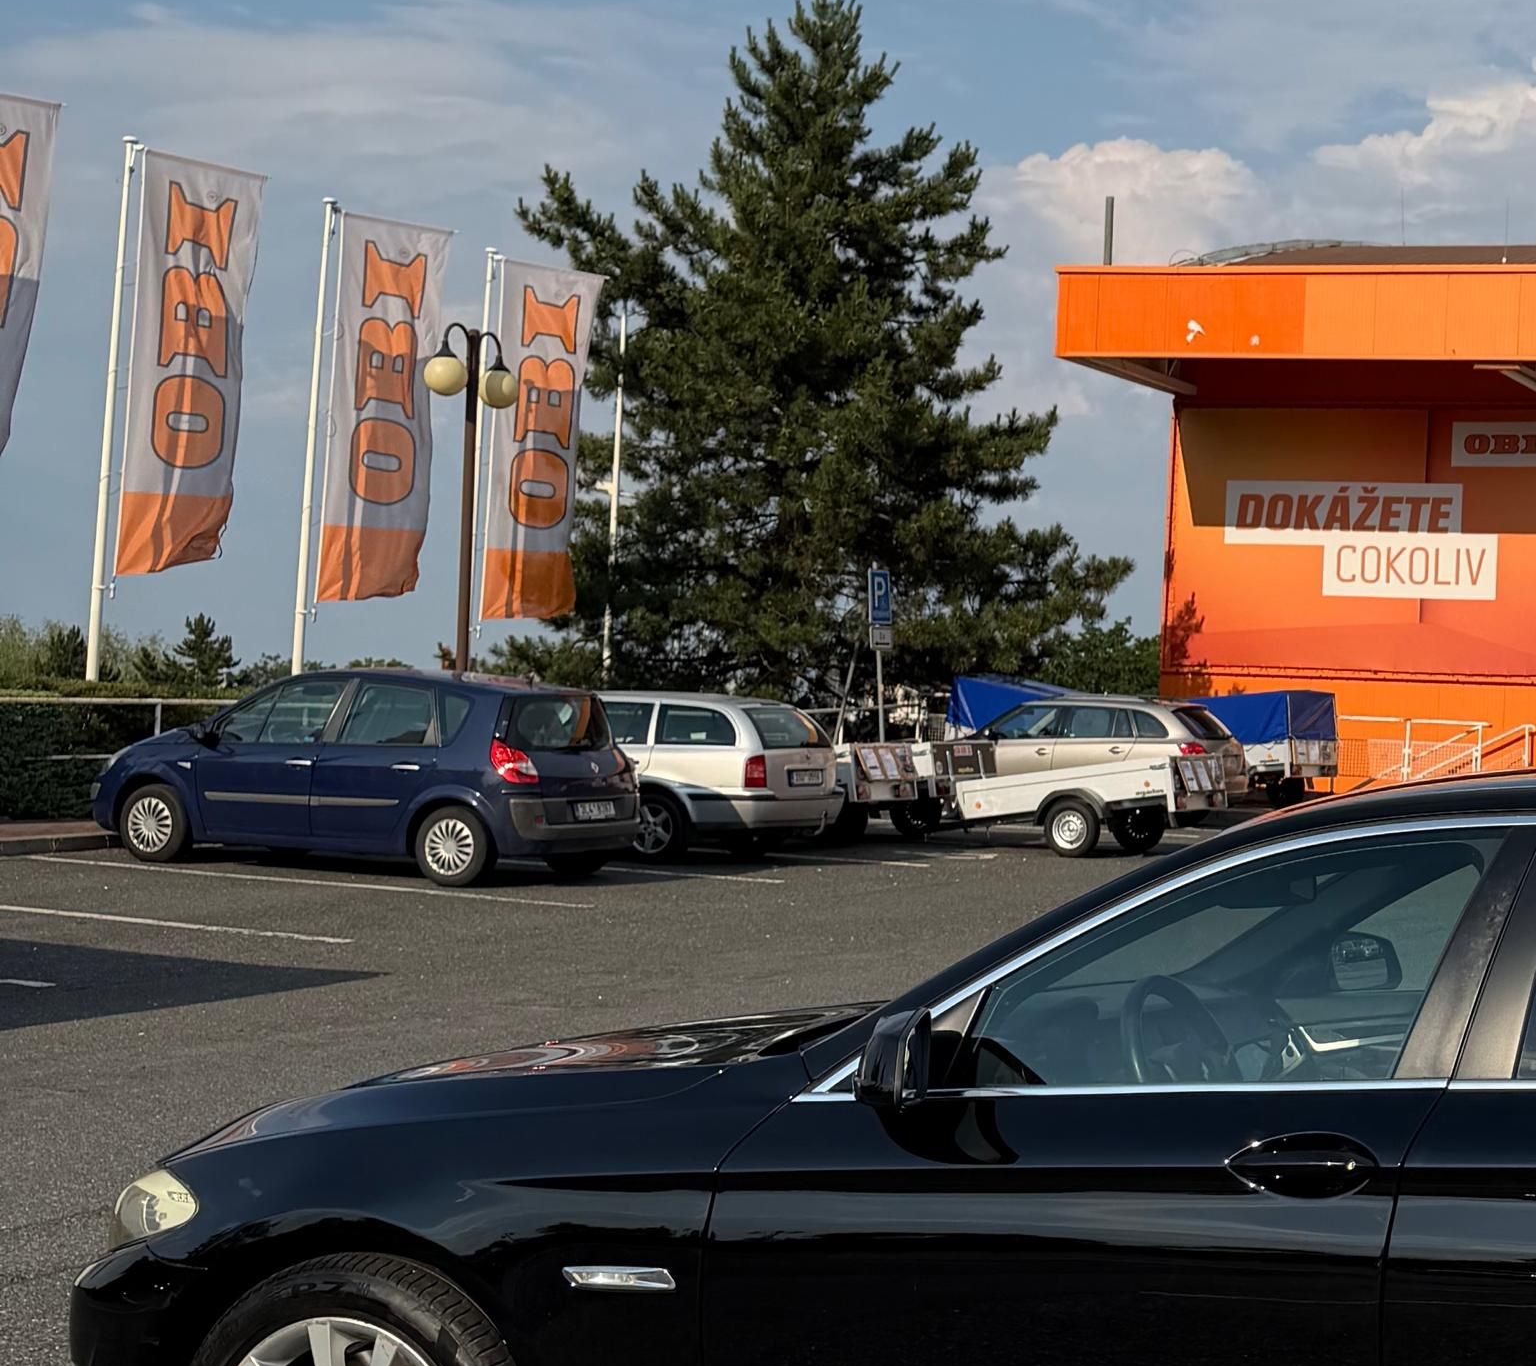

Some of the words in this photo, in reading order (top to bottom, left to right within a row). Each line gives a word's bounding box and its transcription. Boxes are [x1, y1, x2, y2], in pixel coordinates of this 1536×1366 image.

[151, 180, 238, 469] OBI
[349, 240, 427, 505] OBI
[509, 285, 581, 529] OBI
[1235, 485, 1454, 534] DOKÁŽETE
[1336, 544, 1487, 586] COKOLIV
[874, 576, 886, 608] P
